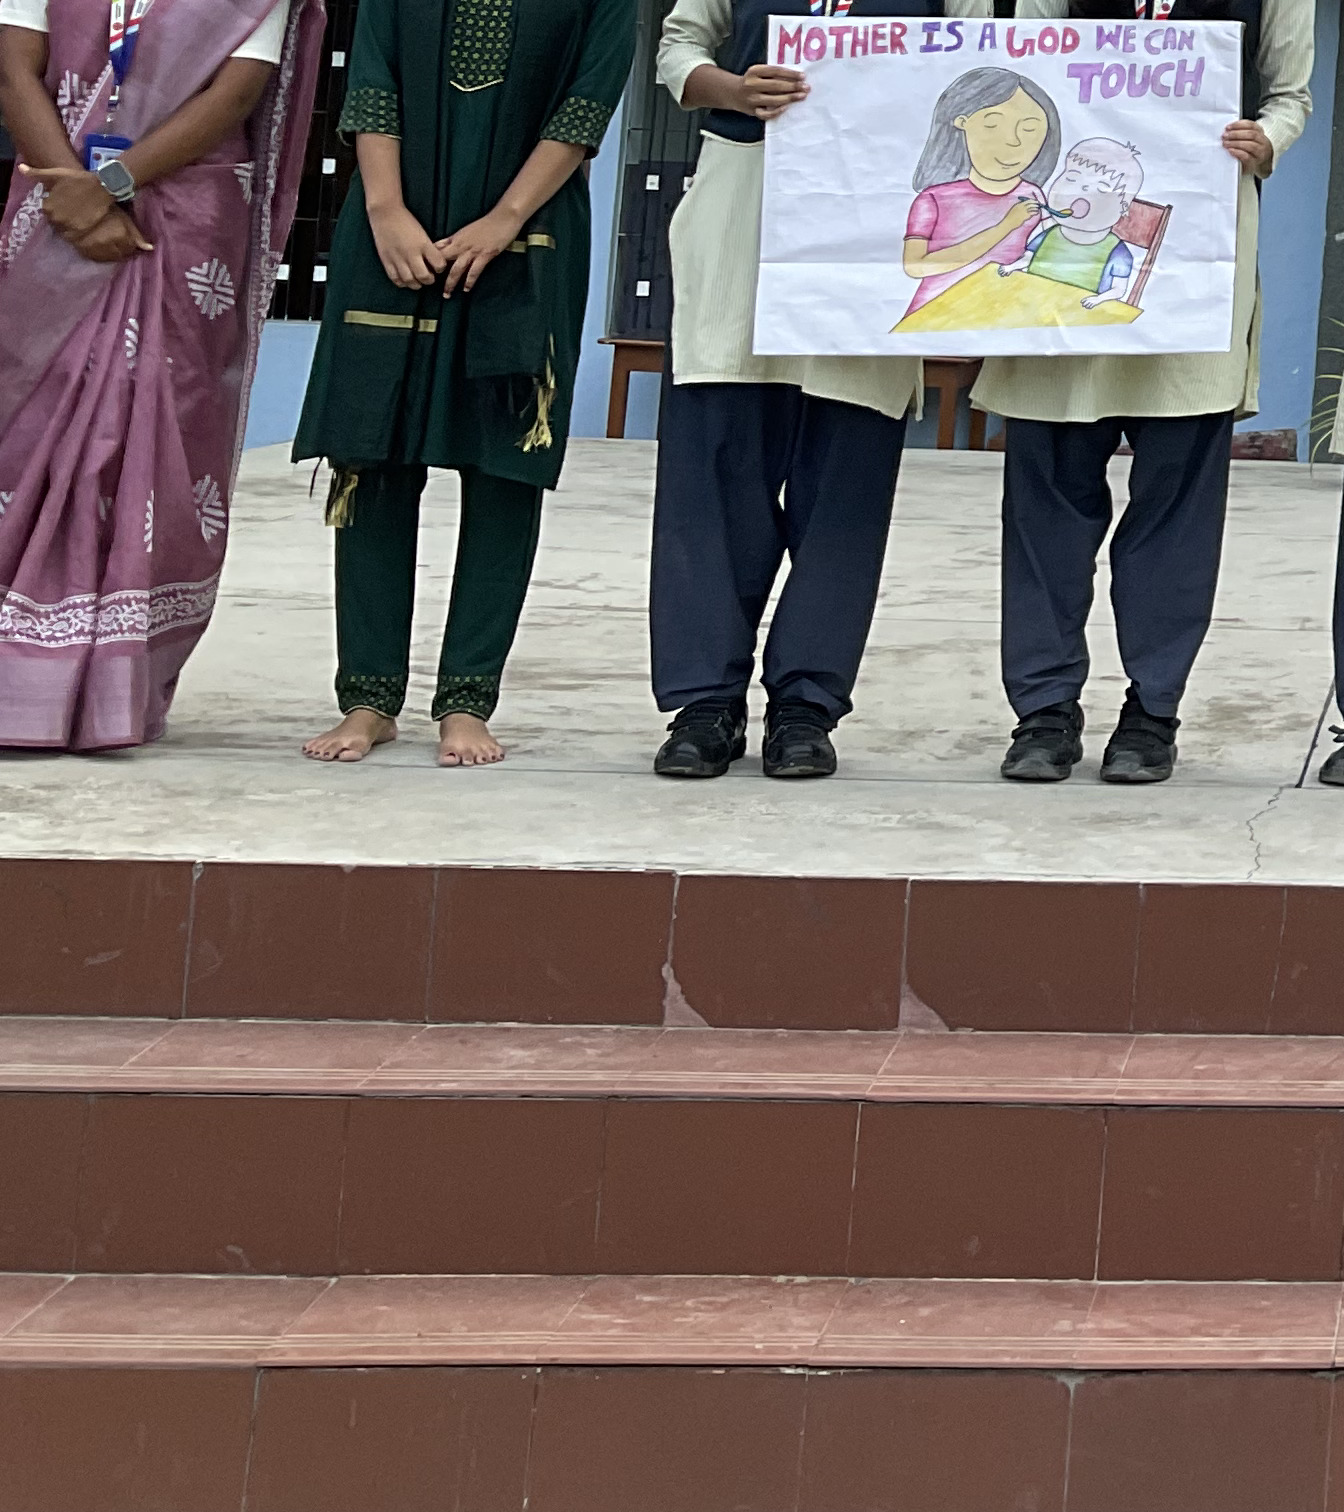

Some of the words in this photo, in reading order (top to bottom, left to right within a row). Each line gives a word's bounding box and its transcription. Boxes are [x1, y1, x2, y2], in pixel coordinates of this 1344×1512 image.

[776, 21, 908, 65] MOTHER
[919, 20, 964, 53] IS
[978, 22, 998, 51] A
[1006, 25, 1080, 57] GOD
[1096, 25, 1137, 53] WE
[1143, 29, 1195, 55] CAN
[1067, 56, 1205, 104] TOUCH
